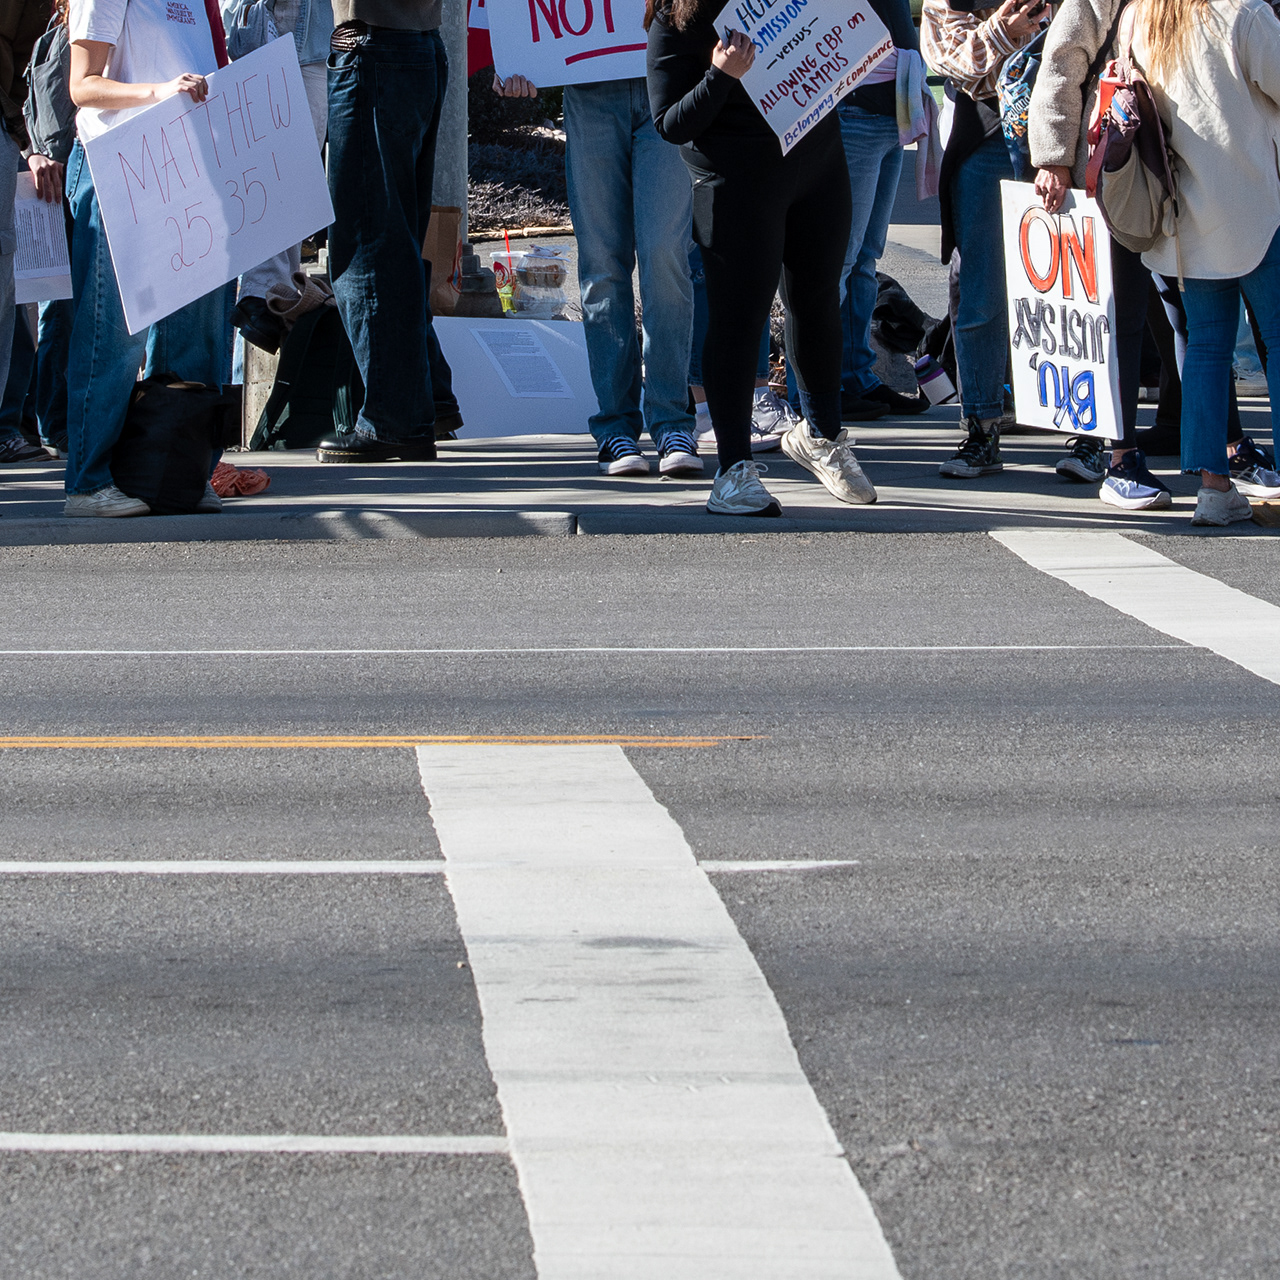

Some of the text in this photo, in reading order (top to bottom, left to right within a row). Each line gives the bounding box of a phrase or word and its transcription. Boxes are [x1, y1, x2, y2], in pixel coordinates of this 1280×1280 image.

[758, 11, 867, 115] ALLOWING CBP on
[791, 51, 849, 108] CAMPUS
[117, 67, 293, 225] MATTHEW
[783, 92, 835, 148] Belonging
[1018, 204, 1101, 306] NO
[1012, 296, 1111, 365] JUST SAY
